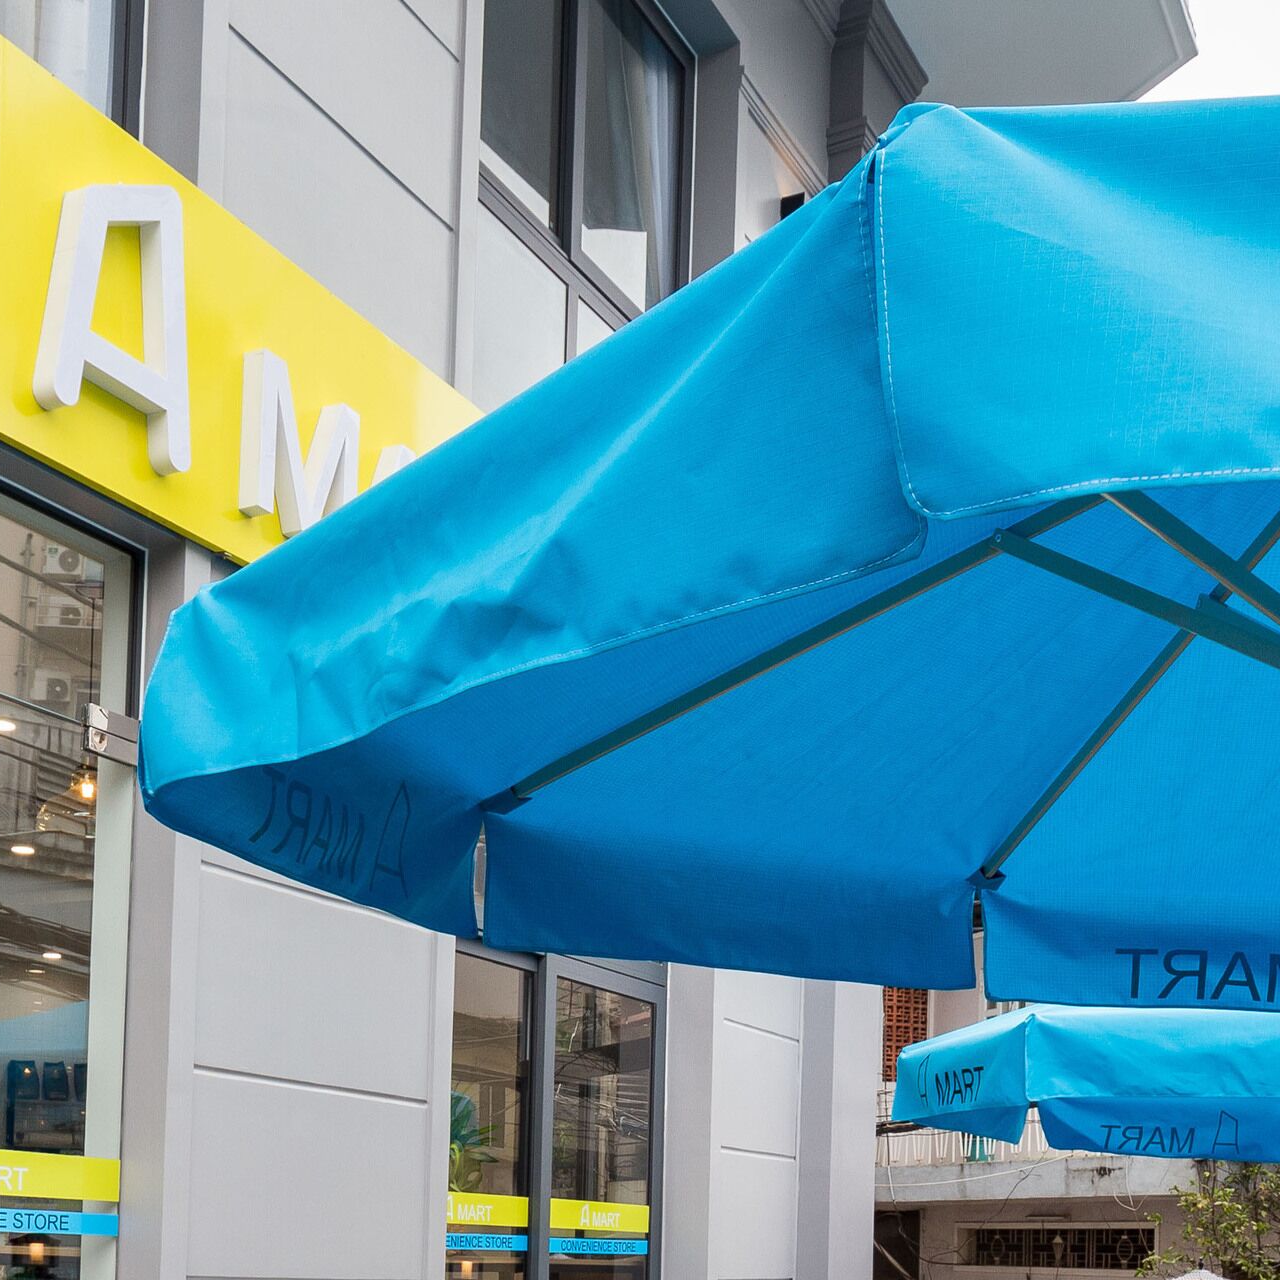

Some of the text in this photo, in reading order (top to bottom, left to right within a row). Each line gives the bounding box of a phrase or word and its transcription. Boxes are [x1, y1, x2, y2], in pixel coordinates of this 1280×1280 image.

[32, 184, 192, 475] A
[935, 1066, 985, 1107] MART
[12, 1212, 70, 1231] STORE
[457, 1203, 494, 1222] MART
[592, 1211, 620, 1229] MART
[485, 1236, 513, 1249] STORE
[561, 1240, 637, 1253] CONVENIENCE STORE
